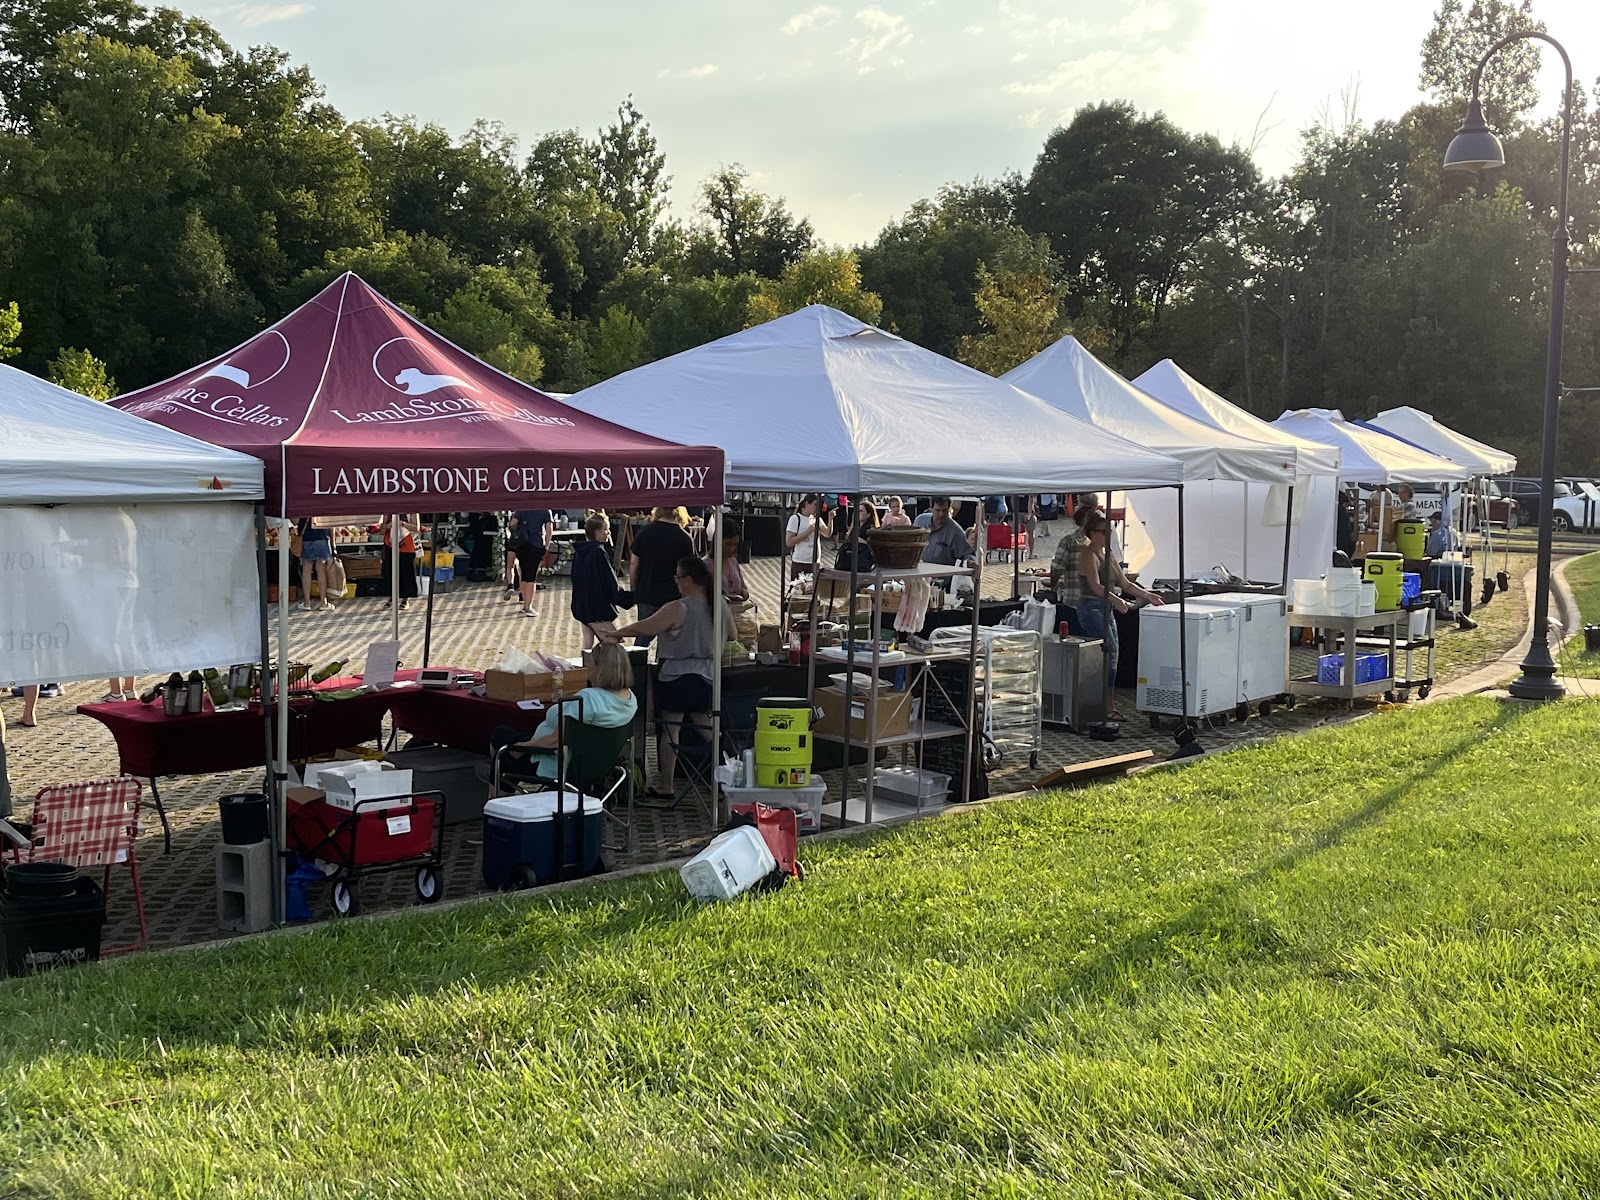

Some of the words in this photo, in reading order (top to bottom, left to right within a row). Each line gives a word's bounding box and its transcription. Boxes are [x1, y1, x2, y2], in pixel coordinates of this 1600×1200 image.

[210, 395, 289, 427] Cellars
[329, 398, 492, 423] LambStone
[490, 401, 576, 427] Cellars
[312, 467, 490, 495] LAMBSTONE
[503, 467, 613, 492] CELLARS
[624, 466, 710, 490] WINERY
